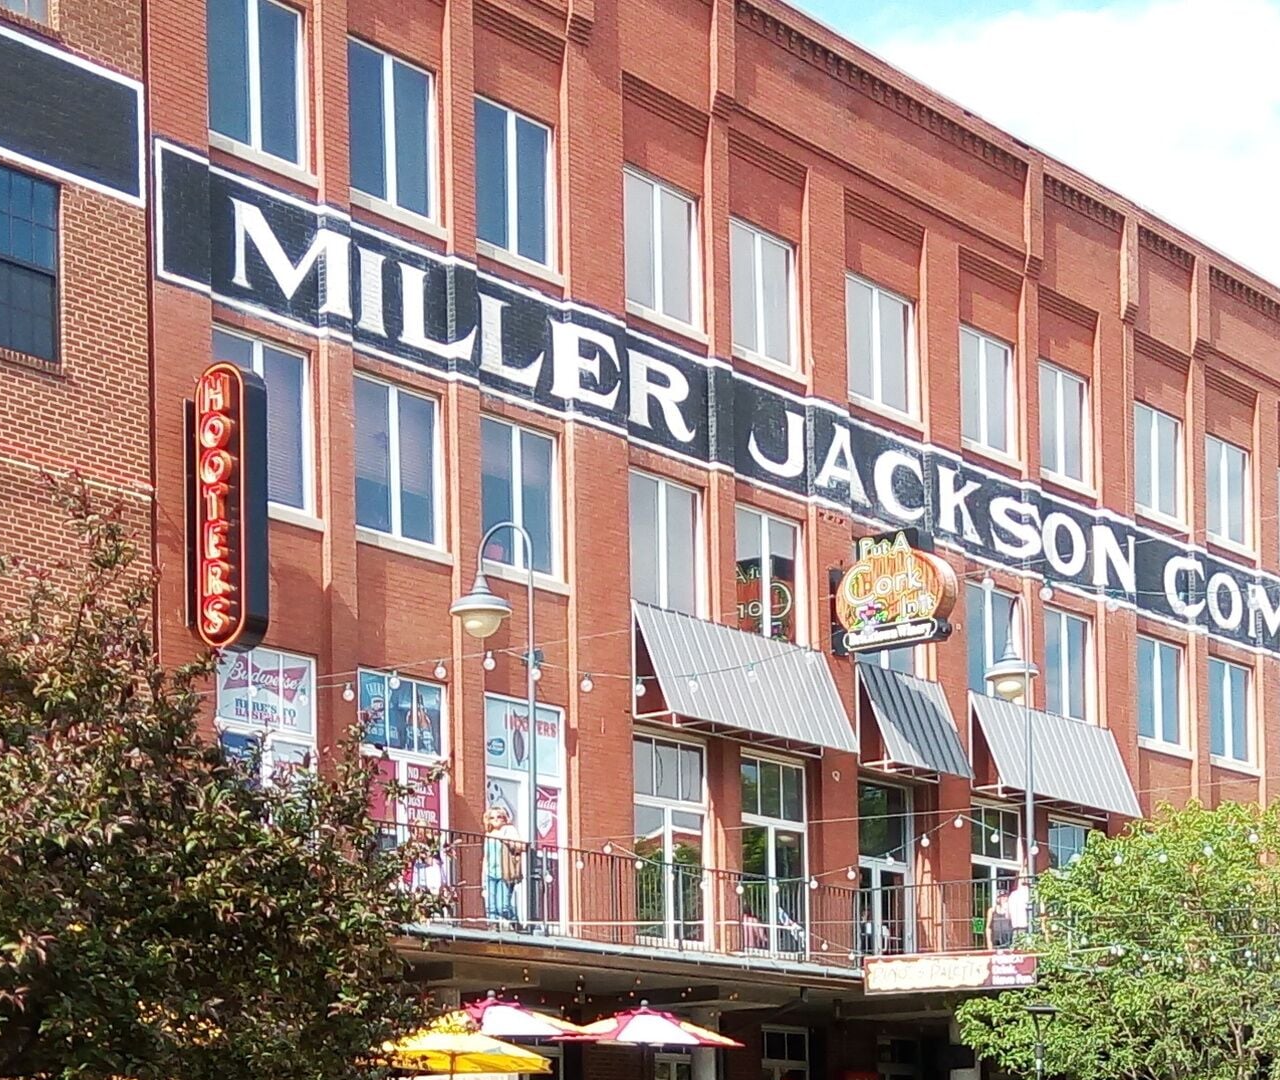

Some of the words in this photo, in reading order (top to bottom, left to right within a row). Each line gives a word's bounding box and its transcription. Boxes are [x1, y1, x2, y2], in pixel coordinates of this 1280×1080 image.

[229, 195, 697, 444] MILLER
[748, 409, 1137, 594] JACKSON
[200, 372, 230, 634] HOOTERS
[860, 537, 890, 560] Put
[893, 530, 911, 555] A
[844, 556, 922, 604] Cork
[230, 661, 303, 690] Budweiser
